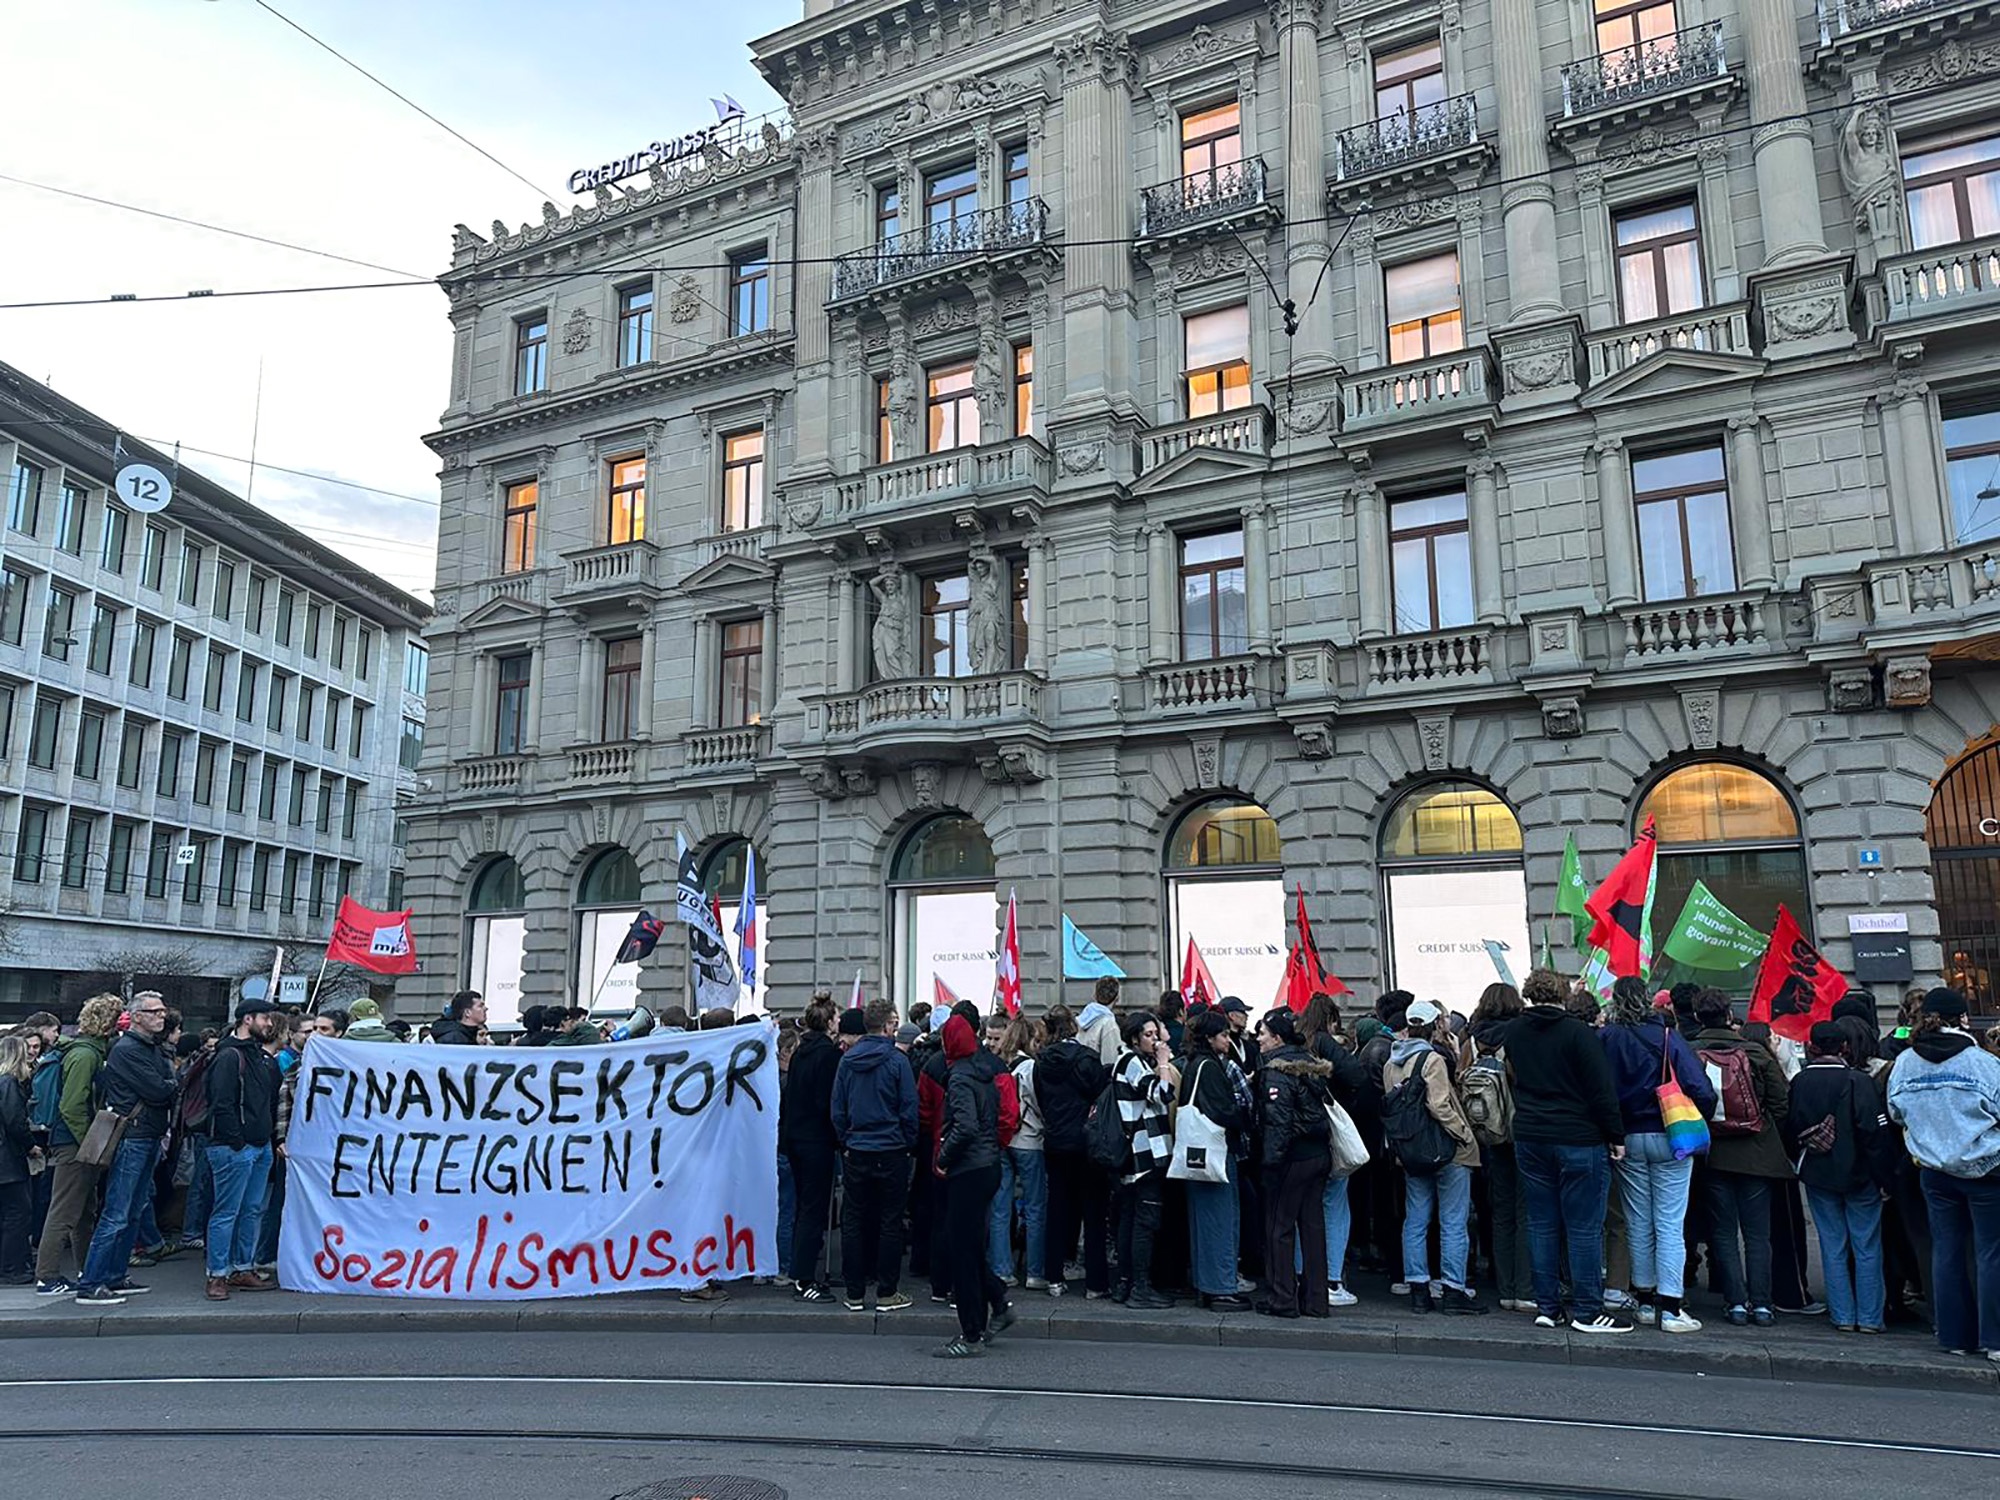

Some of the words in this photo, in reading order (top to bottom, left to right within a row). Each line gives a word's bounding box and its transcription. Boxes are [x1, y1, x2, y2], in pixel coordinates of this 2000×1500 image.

[566, 151, 649, 194] CREDIT
[648, 126, 718, 166] SUISSE
[128, 476, 160, 502] 12
[1979, 818, 2000, 836] C
[179, 850, 193, 860] 42
[1866, 851, 1874, 862] 8
[1200, 947, 1233, 956] CREDIT
[1235, 946, 1264, 955] SUISSE
[1418, 943, 1457, 953] CREDIT
[933, 953, 961, 962] CREDIT
[962, 952, 987, 961] SUISSE
[284, 981, 305, 991] TAXI
[605, 979, 627, 988] CREDIT
[305, 1039, 767, 1125] FINANZSEKTOR
[313, 1212, 756, 1294] Sozialismus.ch
